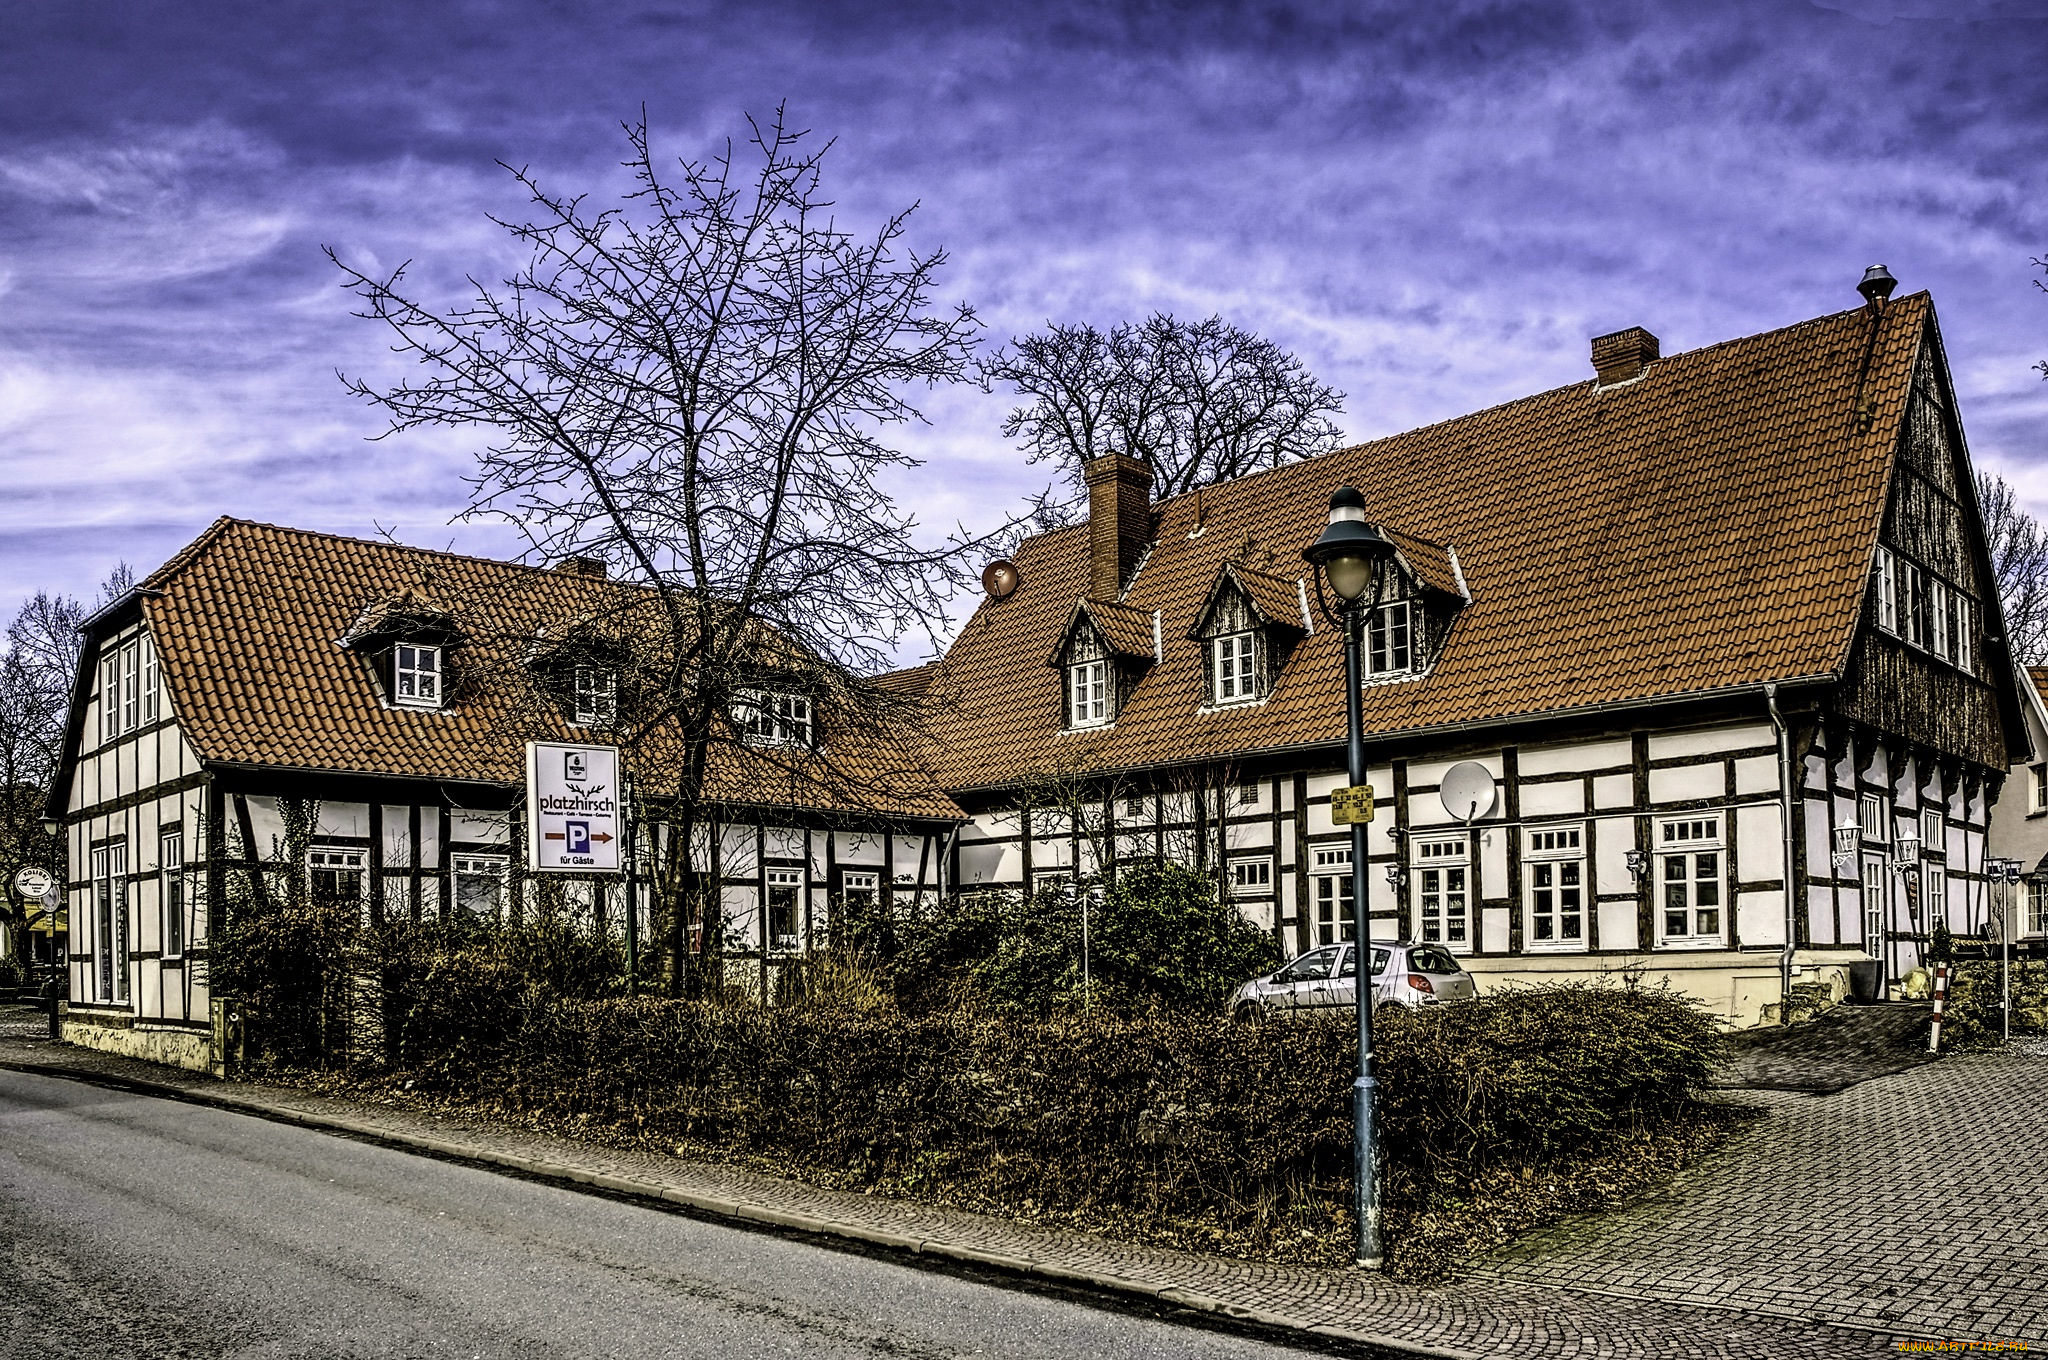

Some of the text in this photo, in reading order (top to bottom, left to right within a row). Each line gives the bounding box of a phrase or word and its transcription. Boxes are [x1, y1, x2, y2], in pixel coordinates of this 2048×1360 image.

[540, 795, 614, 811] platzhirsch
[569, 825, 587, 849] P
[560, 856, 594, 865] für Gäste
[23, 870, 49, 881] KOLIBRI
